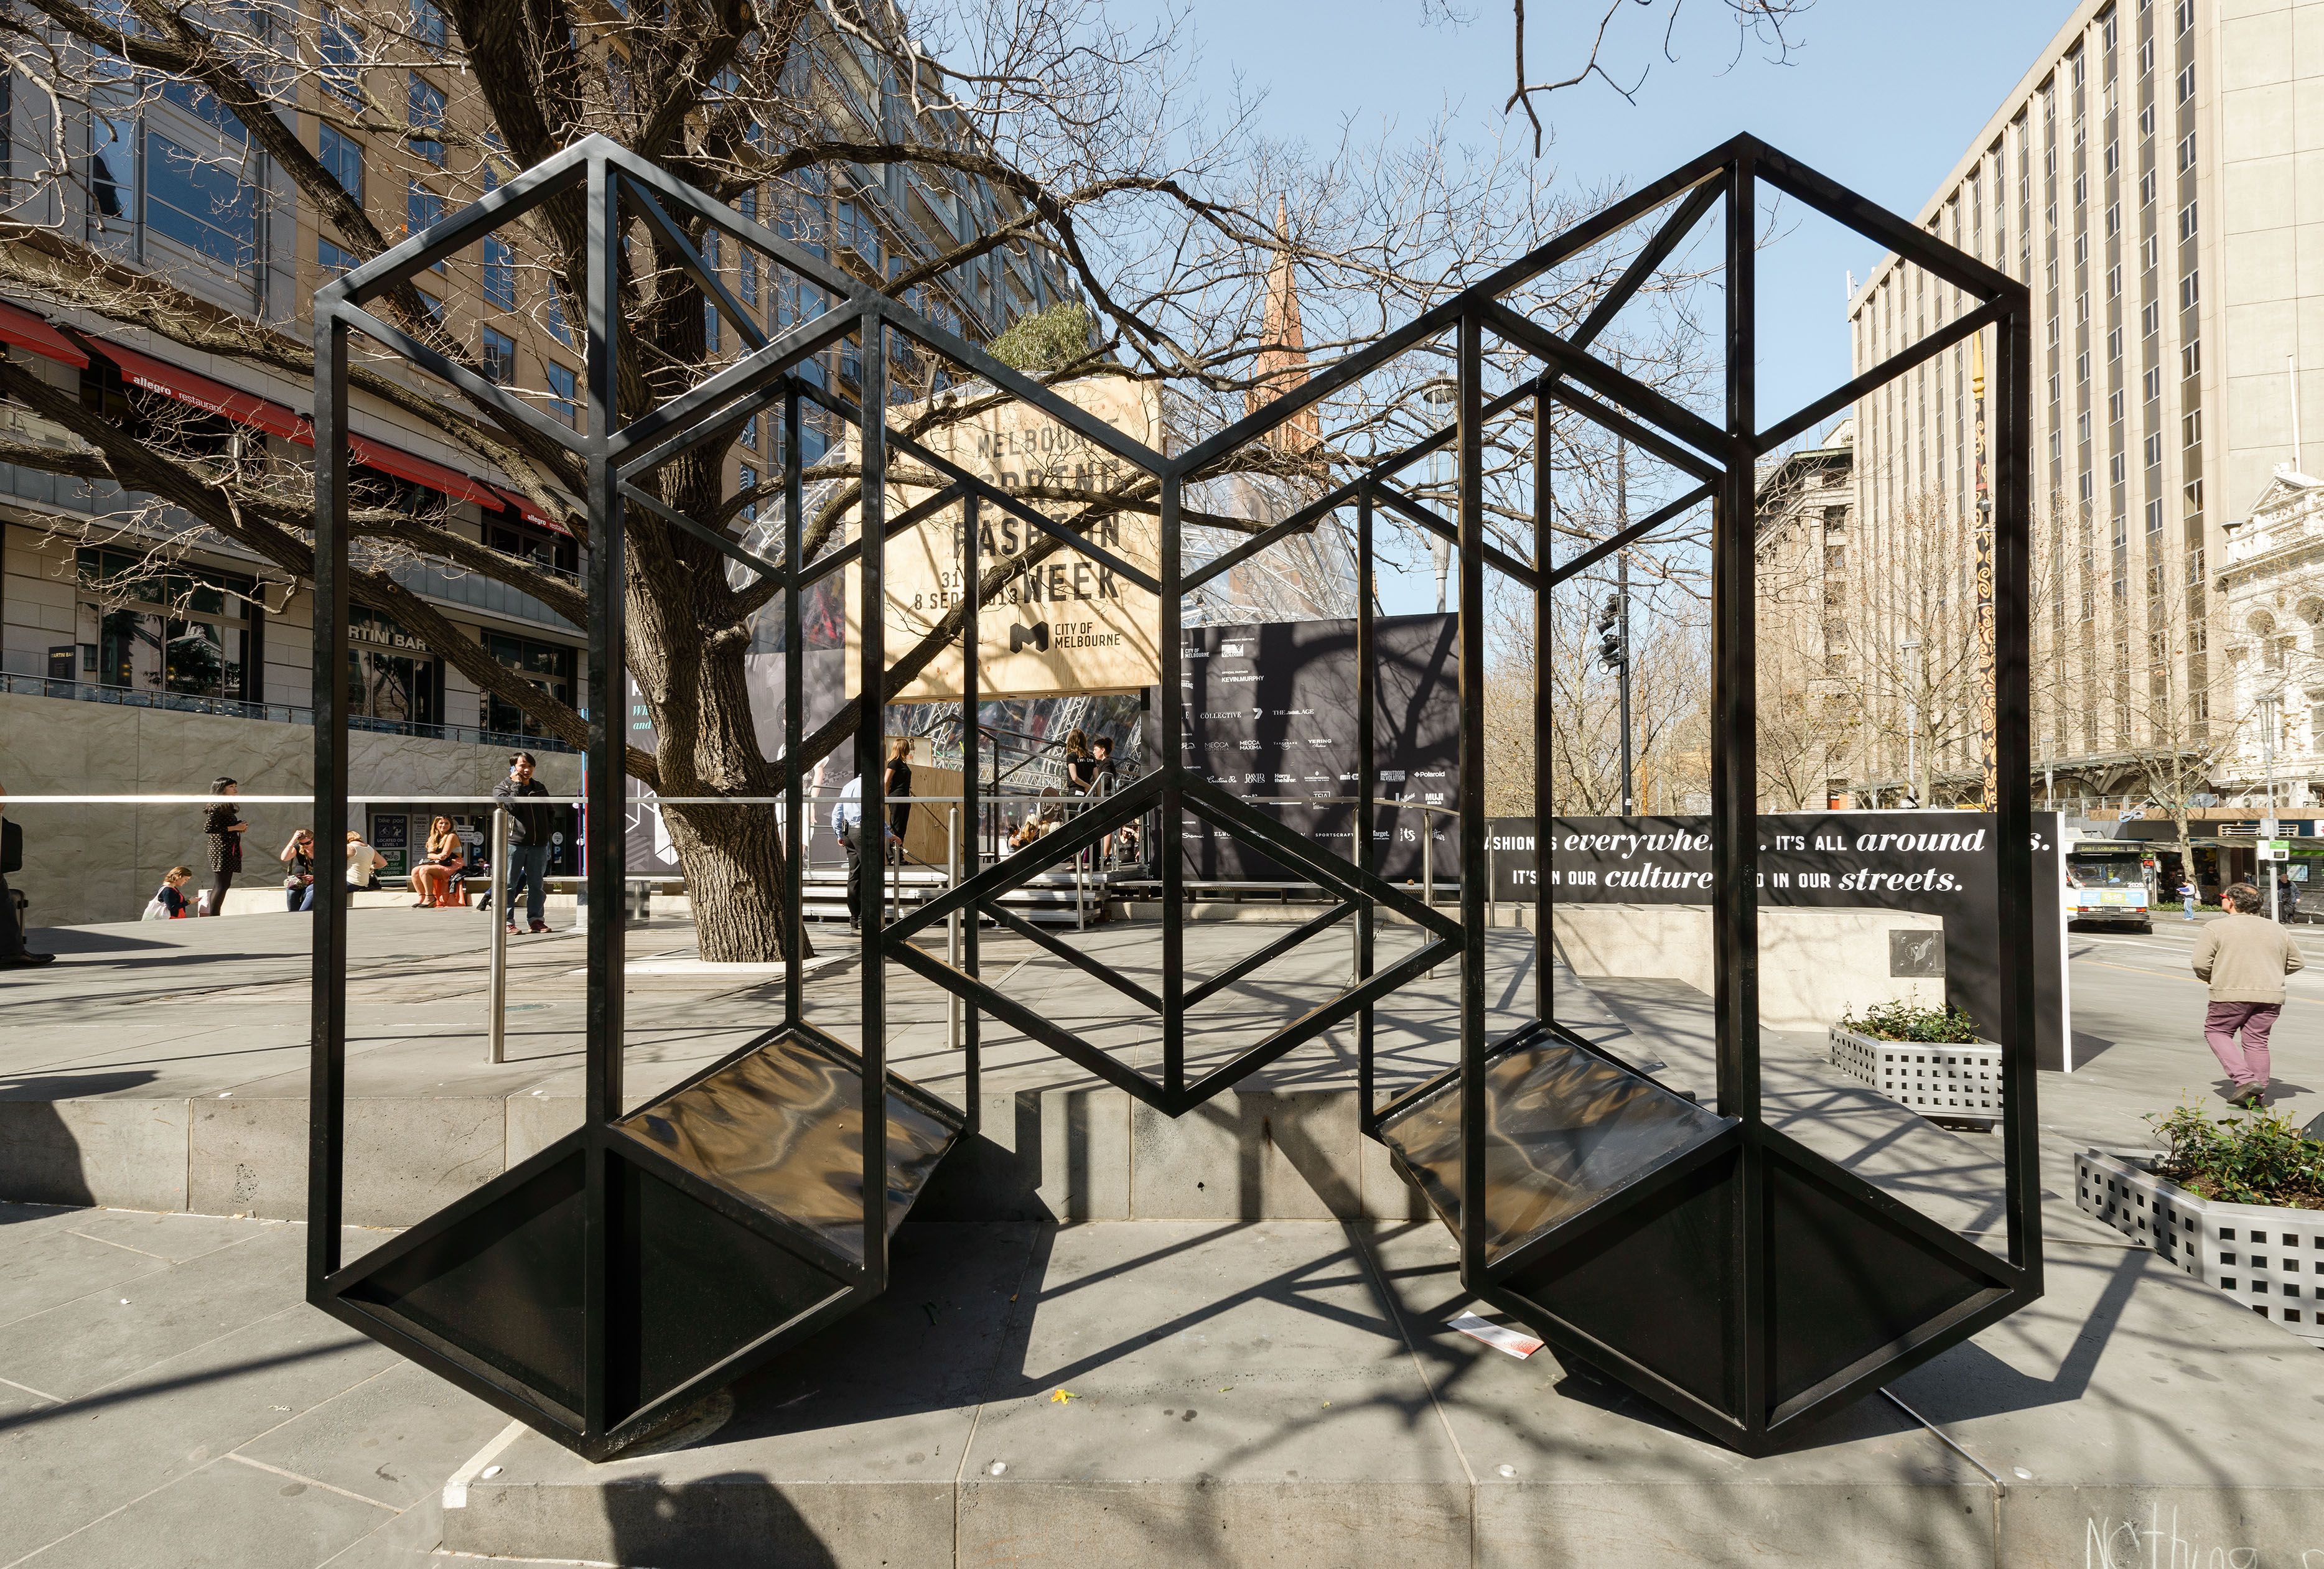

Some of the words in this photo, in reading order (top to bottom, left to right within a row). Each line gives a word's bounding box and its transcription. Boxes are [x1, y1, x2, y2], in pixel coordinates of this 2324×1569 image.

[133, 376, 172, 396] allegro
[179, 392, 223, 414] restaurant
[978, 418, 1119, 460] MELBOU
[953, 512, 1119, 559] FASHIN
[941, 570, 960, 589] 31
[1024, 561, 1119, 603] WEEK
[915, 594, 922, 610] 8
[930, 592, 964, 610] SEP
[1055, 623, 1076, 635] CITY
[1080, 622, 1093, 634] OF
[348, 625, 389, 645] RTINI
[395, 634, 426, 651] BAR
[1055, 633, 1121, 649] MELBOURNE
[1200, 711, 1242, 719] COLLECTIVE
[633, 719, 652, 730] and
[1425, 793, 1444, 801] MUJI
[392, 817, 404, 825] pod
[1404, 827, 1416, 842] ts
[1432, 828, 1446, 841] ittner
[1485, 836, 1535, 850] ASHION
[1776, 836, 1804, 850] IT'S
[1814, 836, 1847, 850] ALL
[1856, 829, 1986, 852] around
[473, 847, 482, 856] P
[554, 846, 561, 854] P
[1513, 870, 1536, 885] IT'S
[1568, 871, 1597, 885] OUR
[1605, 862, 1714, 889] culture
[1773, 873, 1790, 888] IN
[1798, 873, 1831, 888] OUR
[1838, 867, 1963, 892] streets.
